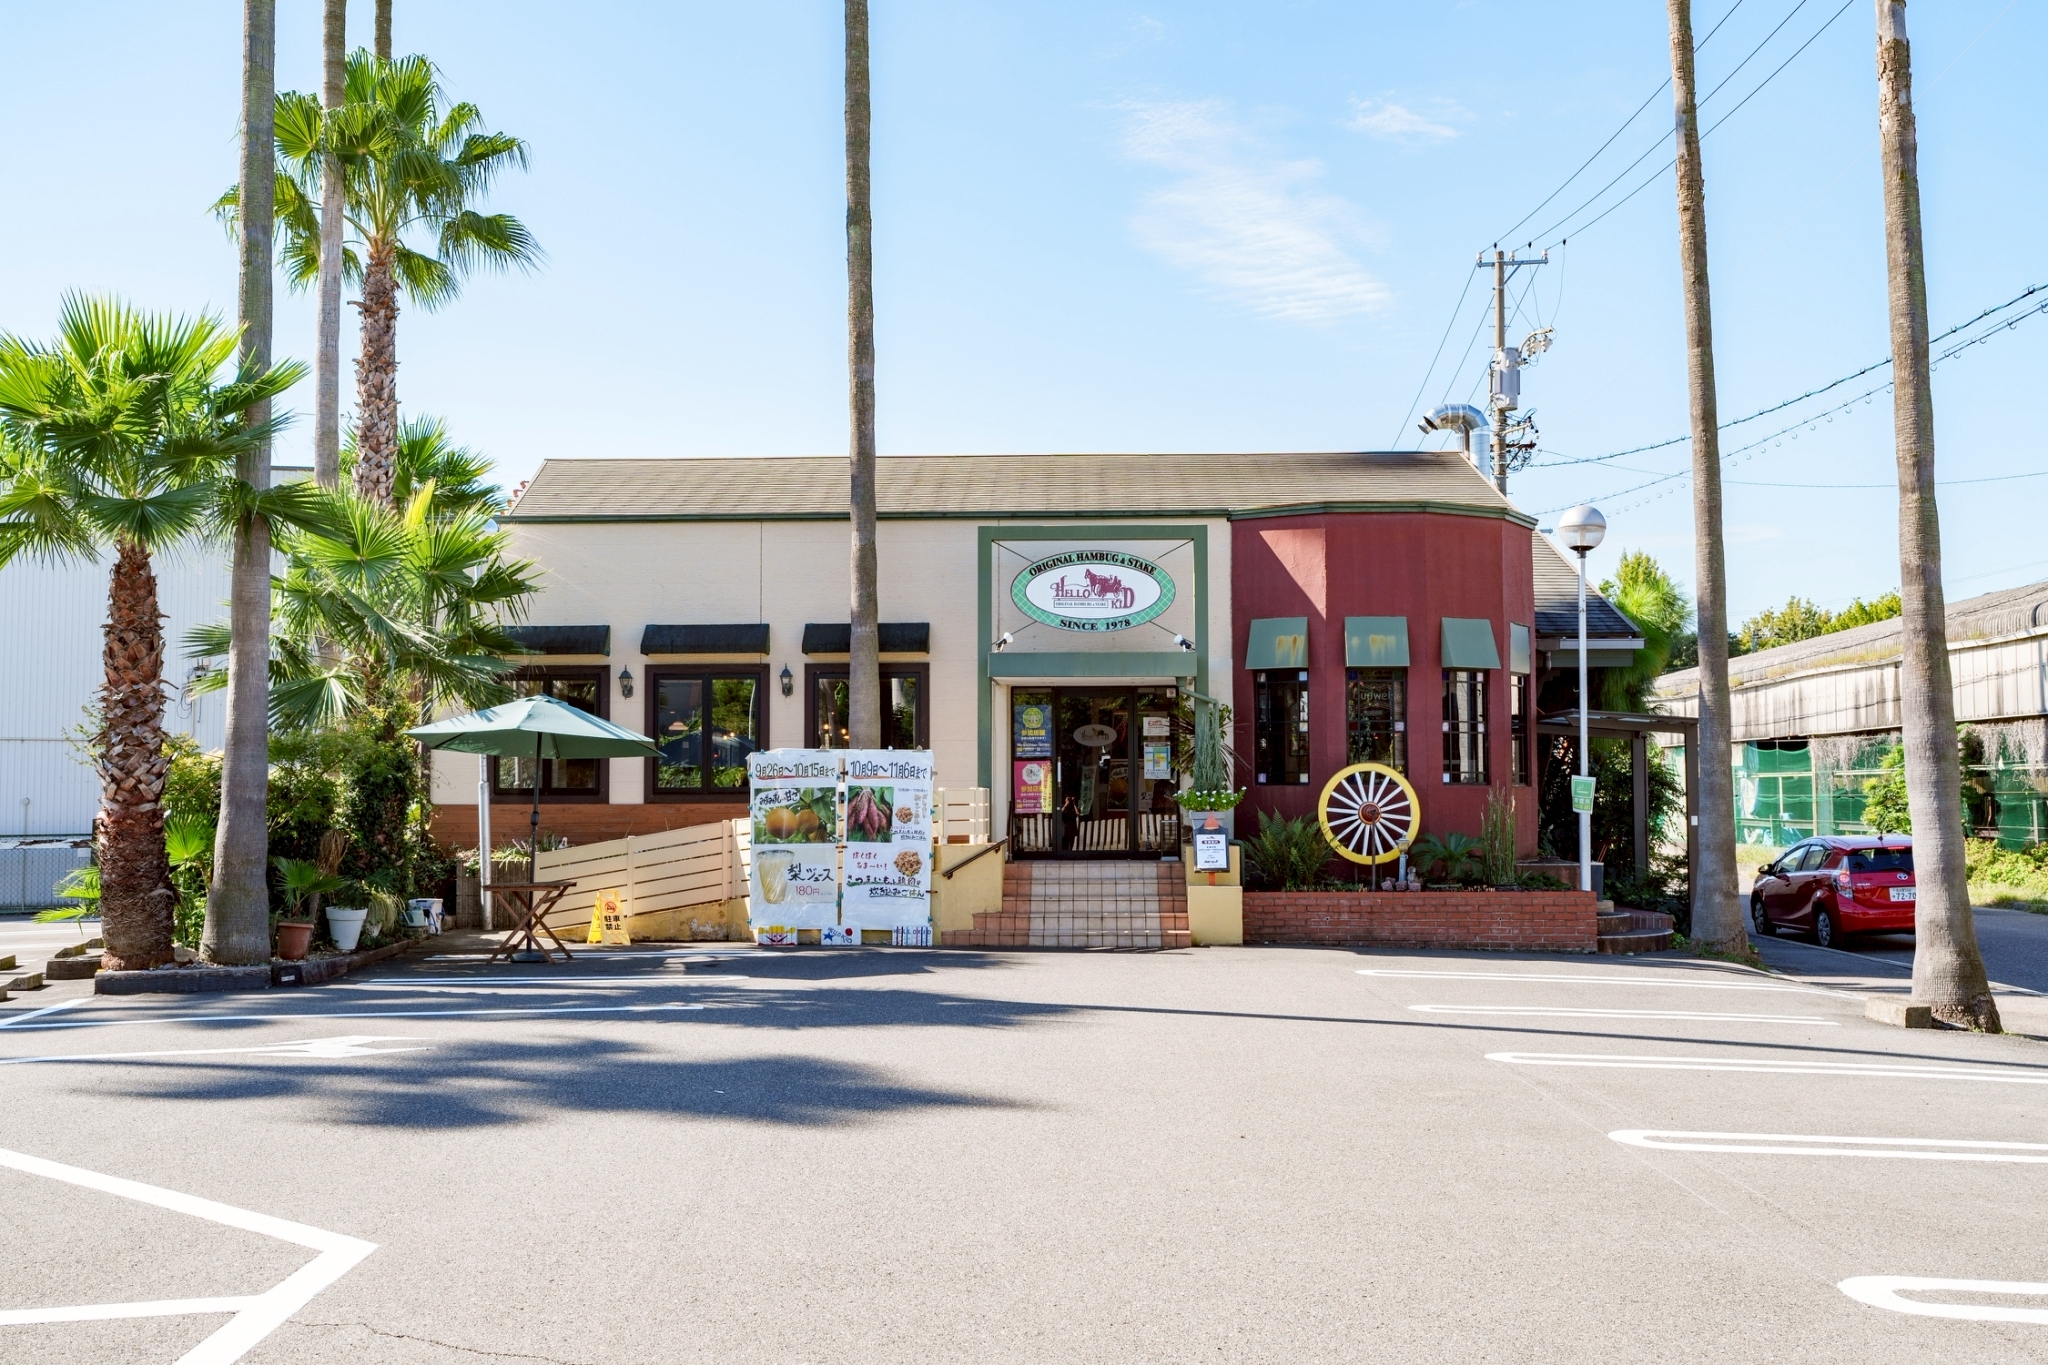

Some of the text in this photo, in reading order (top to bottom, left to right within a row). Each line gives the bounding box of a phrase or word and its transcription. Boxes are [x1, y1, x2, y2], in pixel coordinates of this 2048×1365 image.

[1029, 554, 1075, 576] ORIGINAL
[1076, 552, 1119, 563] HAMBUG
[1127, 557, 1157, 576] STAKE
[1059, 618, 1131, 631] SINCE 1978
[795, 885, 820, 896] 180円
